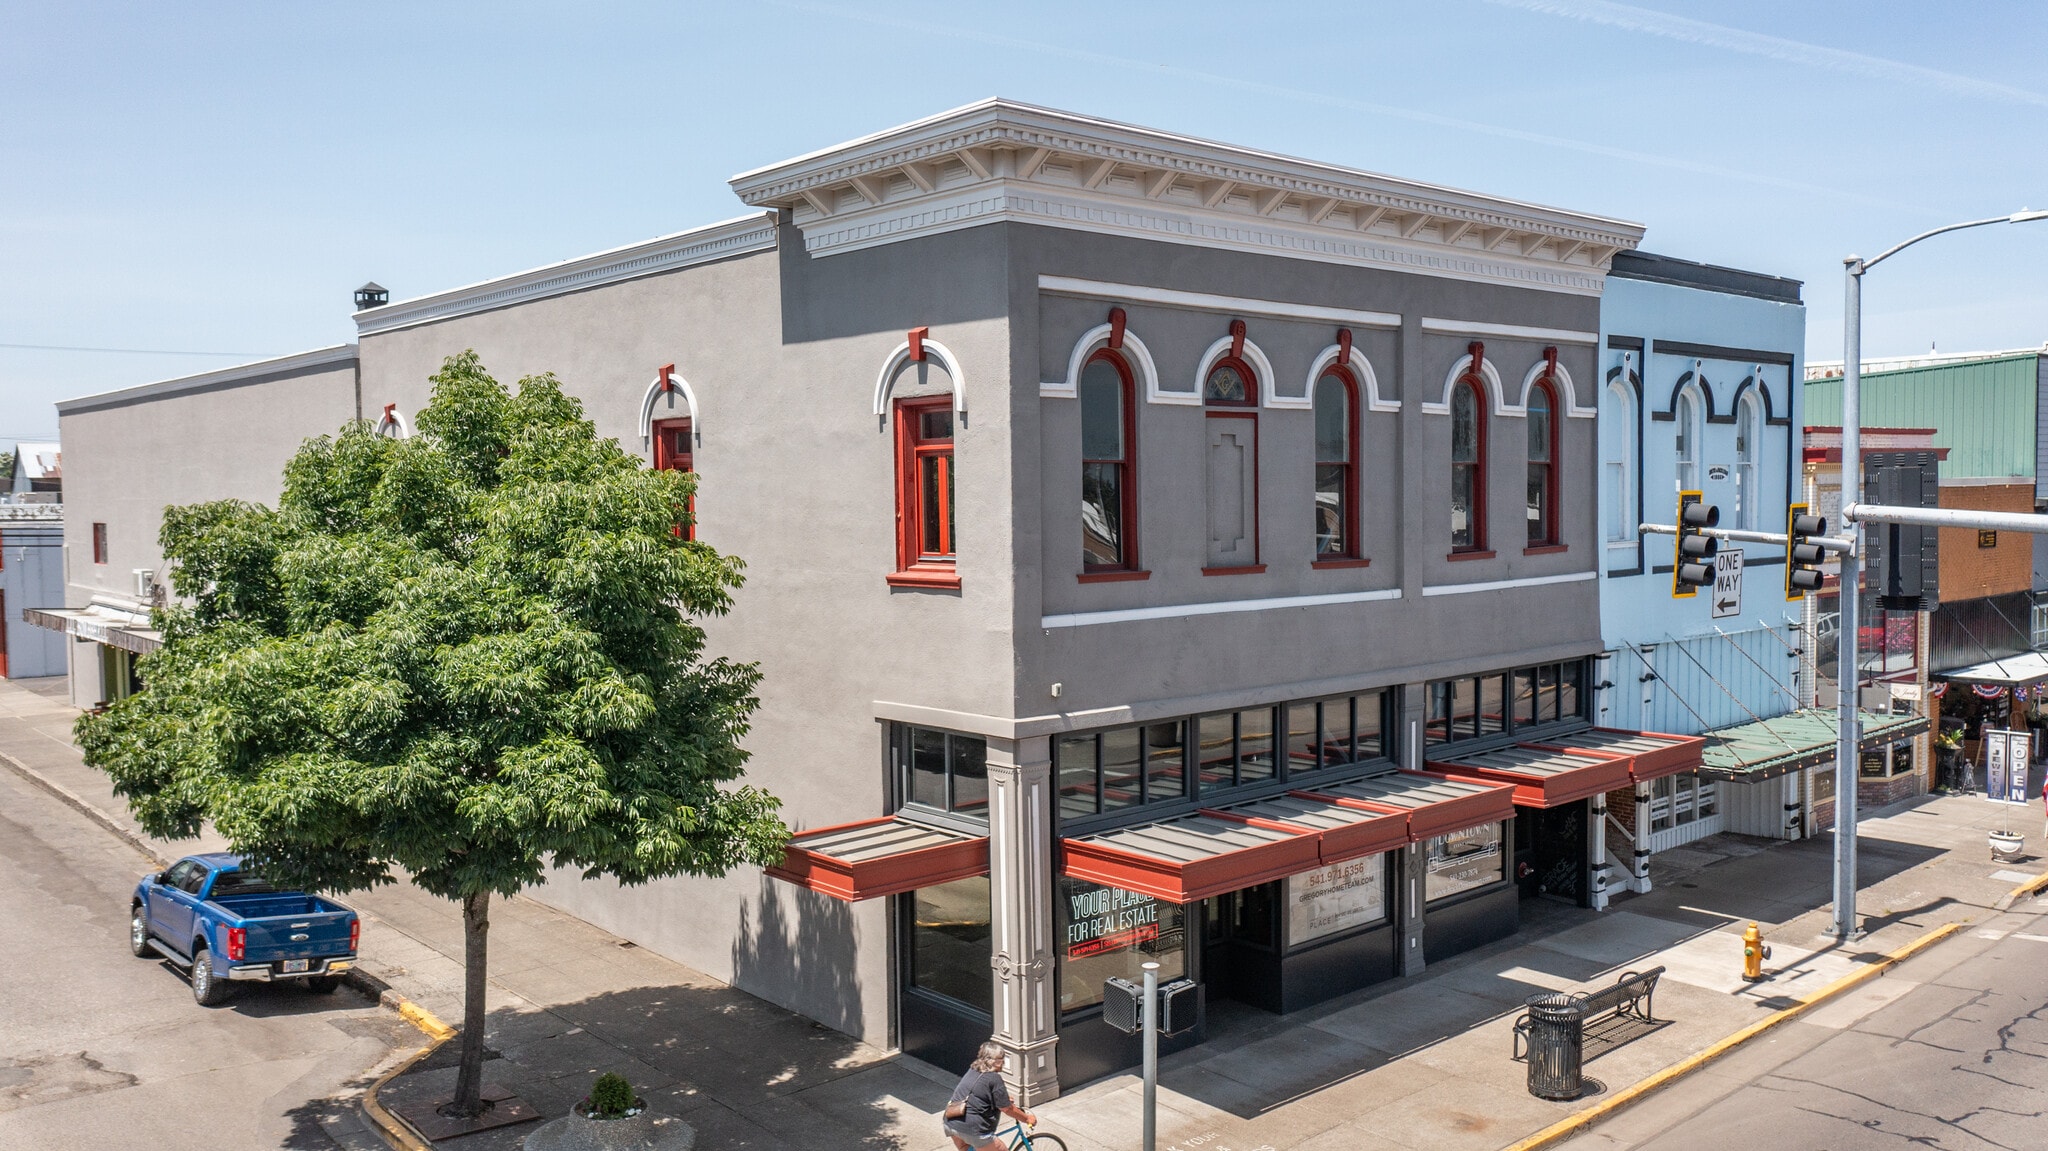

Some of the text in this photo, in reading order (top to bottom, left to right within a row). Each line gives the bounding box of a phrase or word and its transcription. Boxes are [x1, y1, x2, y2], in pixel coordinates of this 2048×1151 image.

[1718, 553, 1739, 571] ONE
[1717, 574, 1739, 592] WAY
[2011, 747, 2027, 801] OPEN
[1309, 862, 1364, 887] 541.971.6356
[1299, 875, 1375, 902] GREGORYHOMETEAM.COM
[1071, 886, 1154, 920] YOUR PLA
[1068, 921, 1089, 943] FOR
[1090, 915, 1117, 938] REAL
[1119, 903, 1159, 930] ESTATE
[1309, 917, 1332, 929] PLACE
[1181, 1131, 1221, 1148] YOUR
